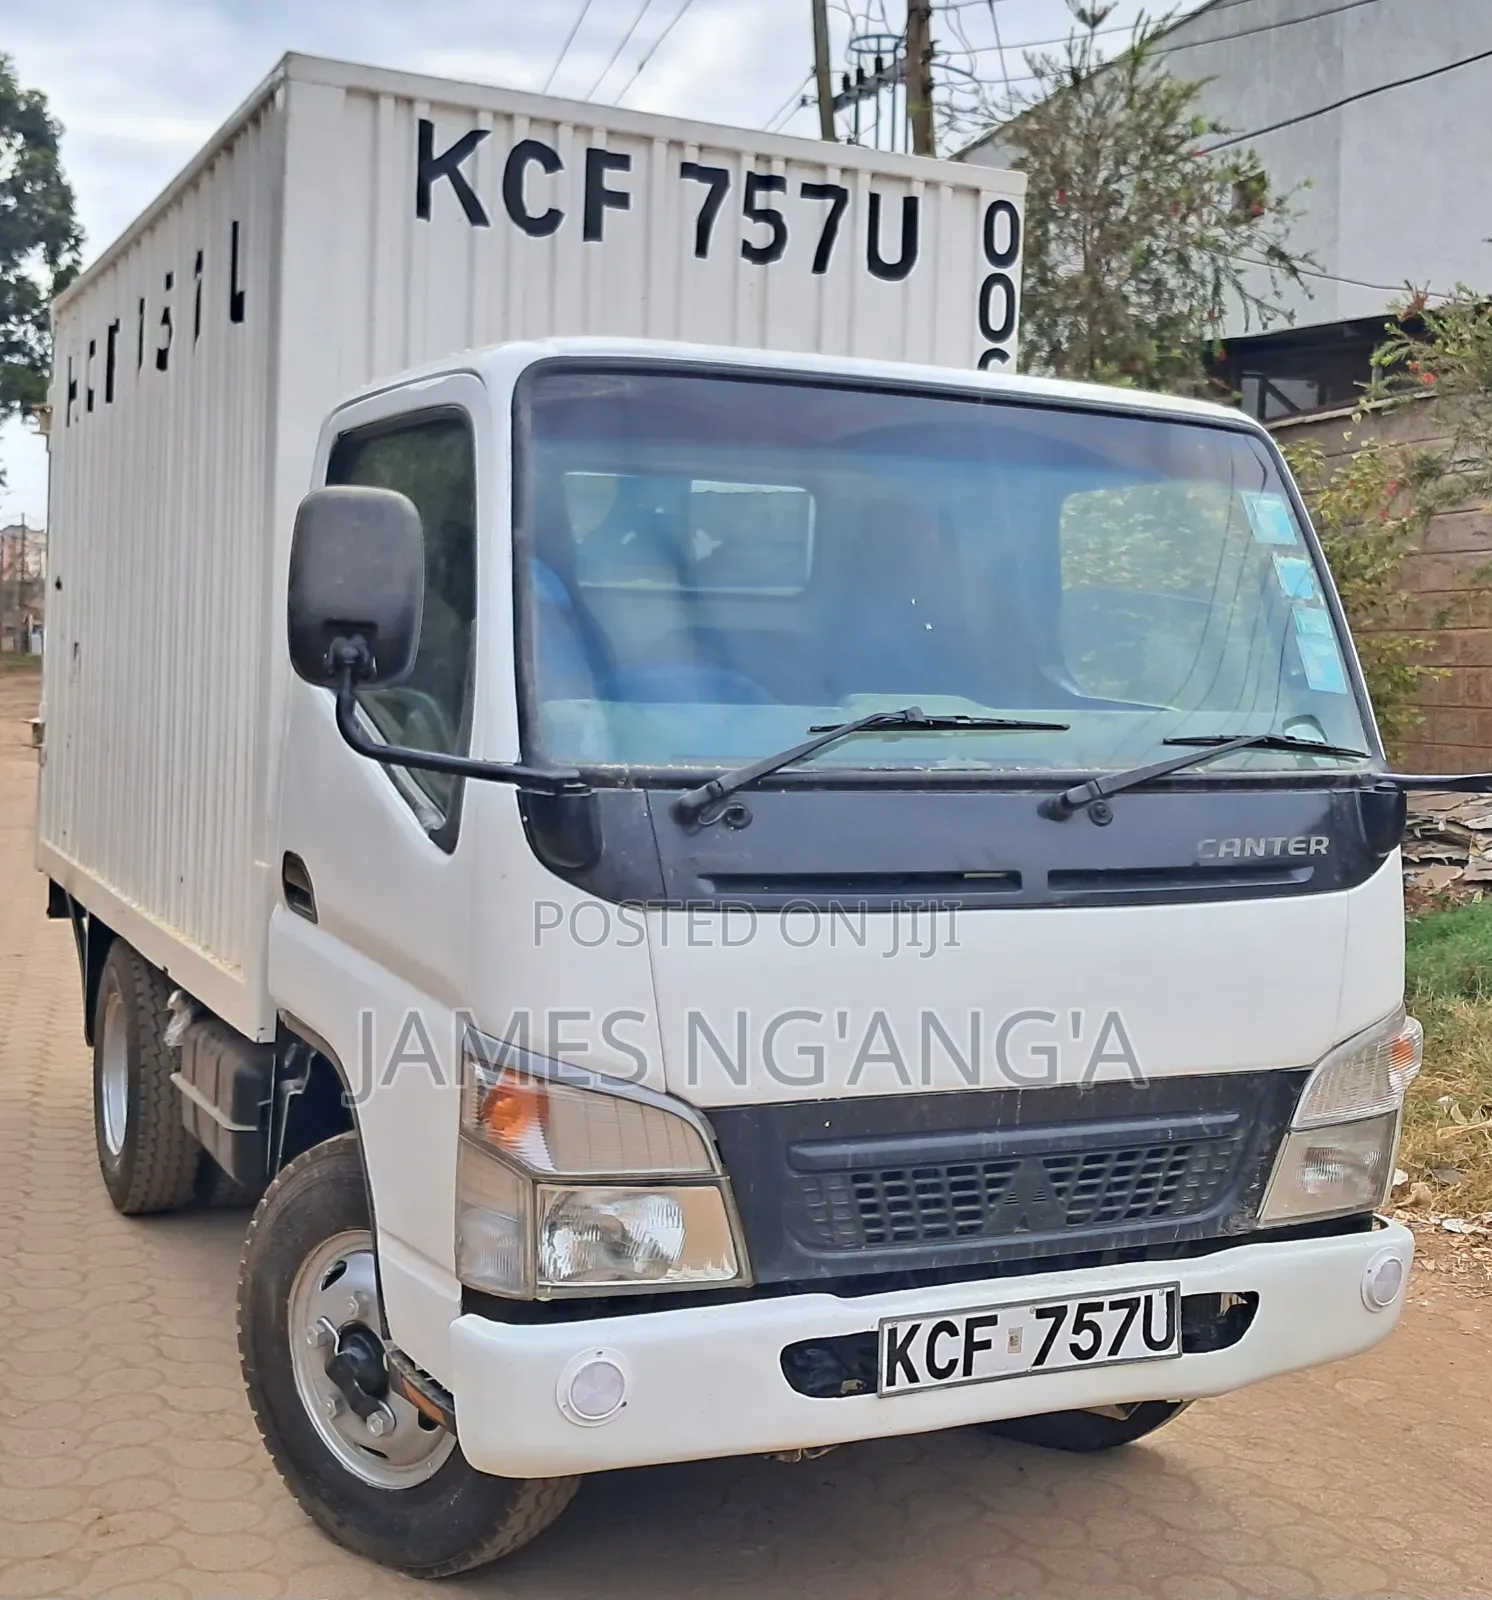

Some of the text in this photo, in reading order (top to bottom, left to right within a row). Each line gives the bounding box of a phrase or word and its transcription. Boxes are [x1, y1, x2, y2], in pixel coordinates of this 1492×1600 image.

[416, 119, 919, 281] KCF 757U
[1198, 836, 1330, 858] CANTER
[885, 1290, 1175, 1387] KCF 757U
